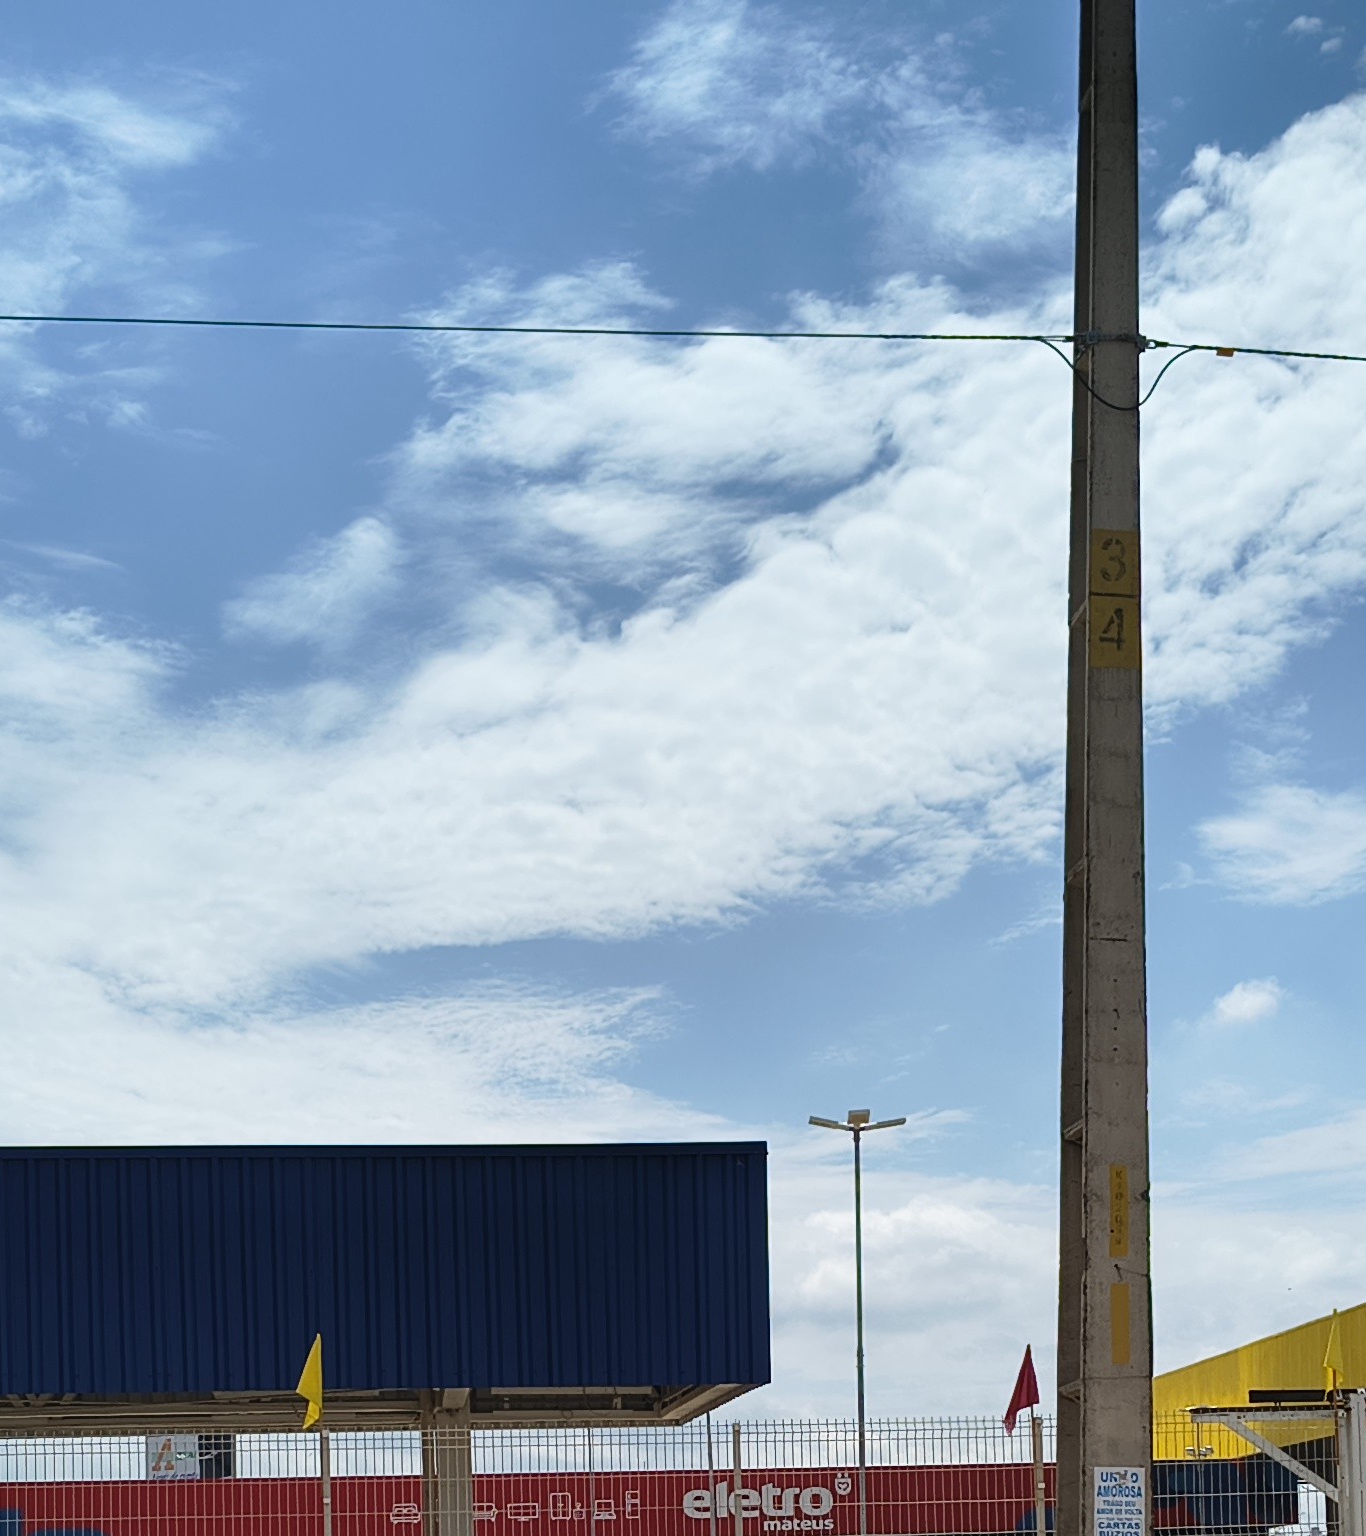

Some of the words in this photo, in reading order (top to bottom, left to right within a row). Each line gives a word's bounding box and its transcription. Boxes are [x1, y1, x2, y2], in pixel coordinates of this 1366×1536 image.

[1099, 537, 1127, 582] 3
[1098, 607, 1126, 651] 4
[1100, 1471, 1139, 1484] UNO
[1097, 1485, 1143, 1498] AMOROSA
[683, 1480, 834, 1519] eletro
[763, 1518, 835, 1531] mateus
[1098, 1522, 1141, 1530] CARTAS
